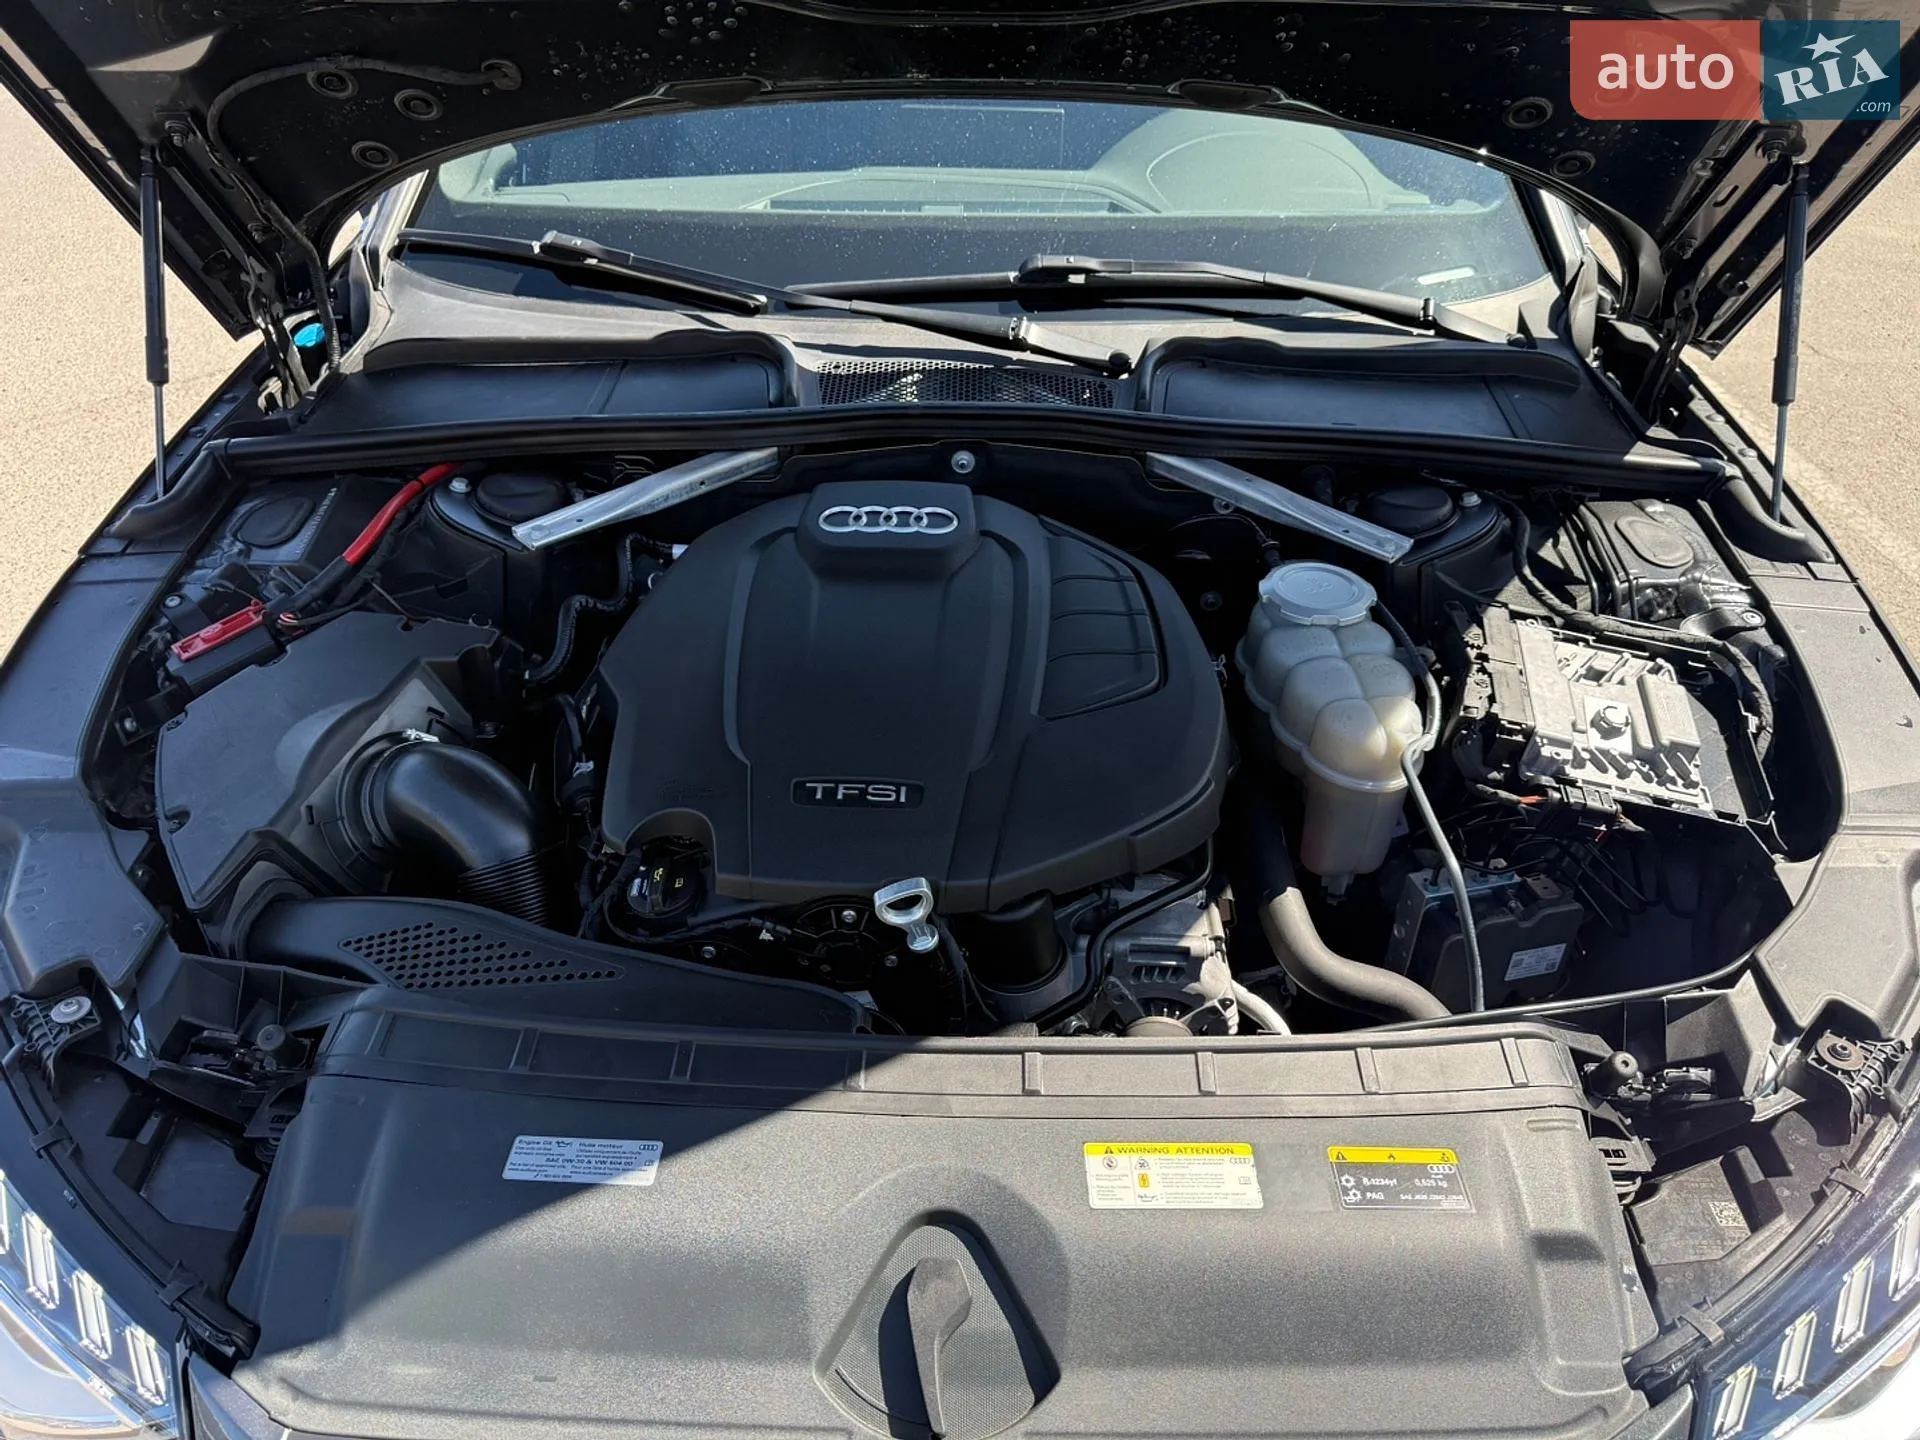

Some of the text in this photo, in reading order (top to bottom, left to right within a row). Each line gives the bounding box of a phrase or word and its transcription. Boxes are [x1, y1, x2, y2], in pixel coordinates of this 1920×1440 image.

[805, 782, 907, 803] TFSI
[1117, 1146, 1235, 1155] WARNING ATTENTION
